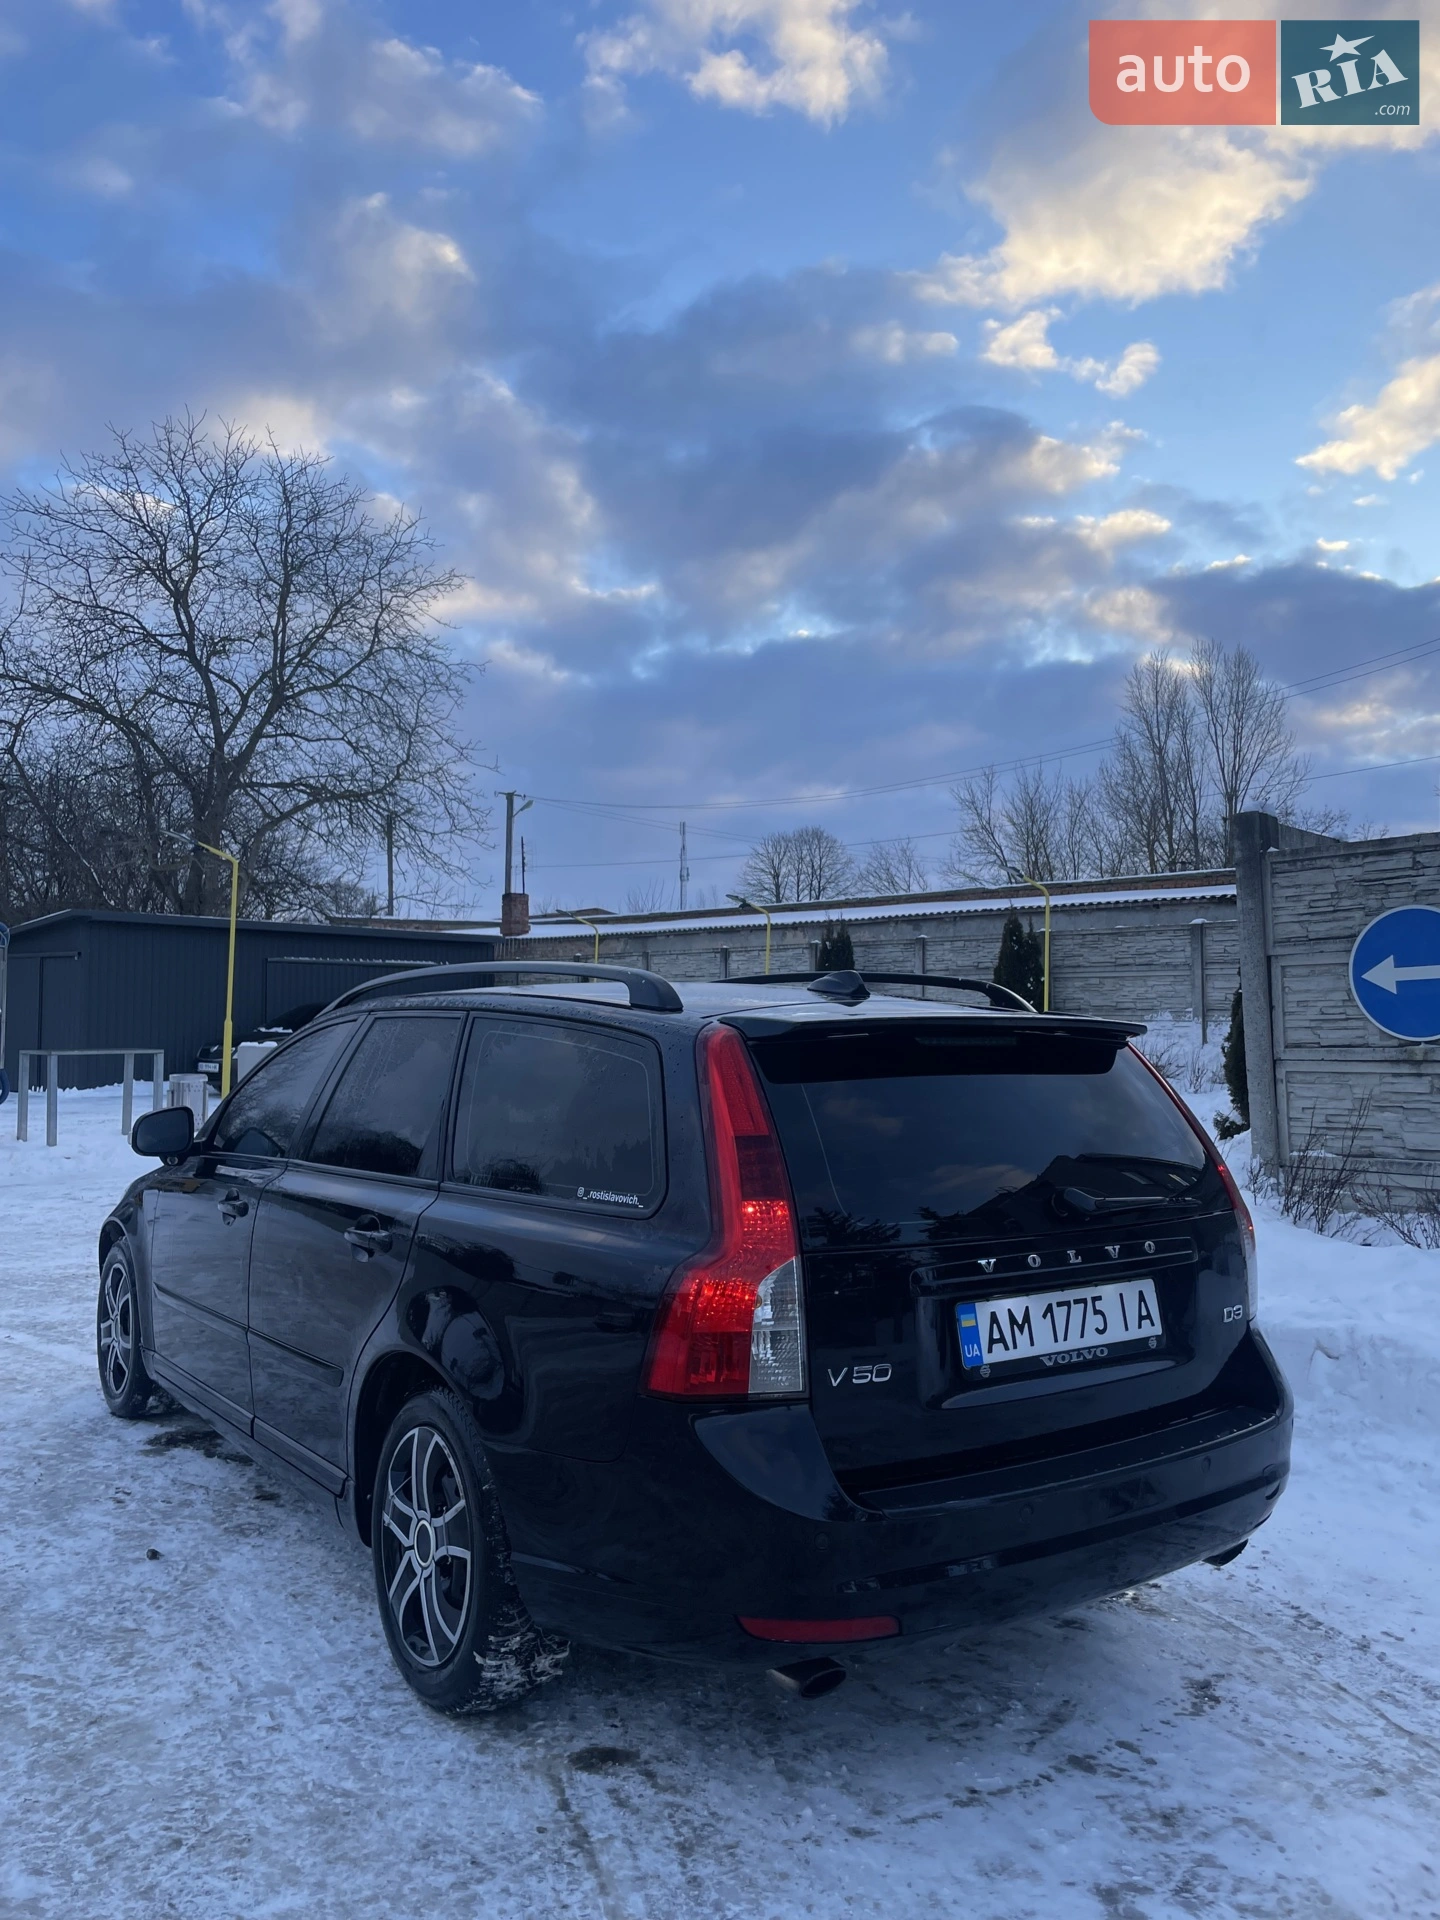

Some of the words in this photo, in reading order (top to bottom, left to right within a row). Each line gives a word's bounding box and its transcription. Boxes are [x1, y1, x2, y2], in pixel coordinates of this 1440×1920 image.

[977, 1240, 1156, 1273] VOLVO
[1223, 1304, 1243, 1323] D3
[987, 1305, 1035, 1354] AM
[1041, 1295, 1108, 1343] 1775
[964, 1343, 981, 1358] UA
[1040, 1346, 1109, 1367] VOLVO
